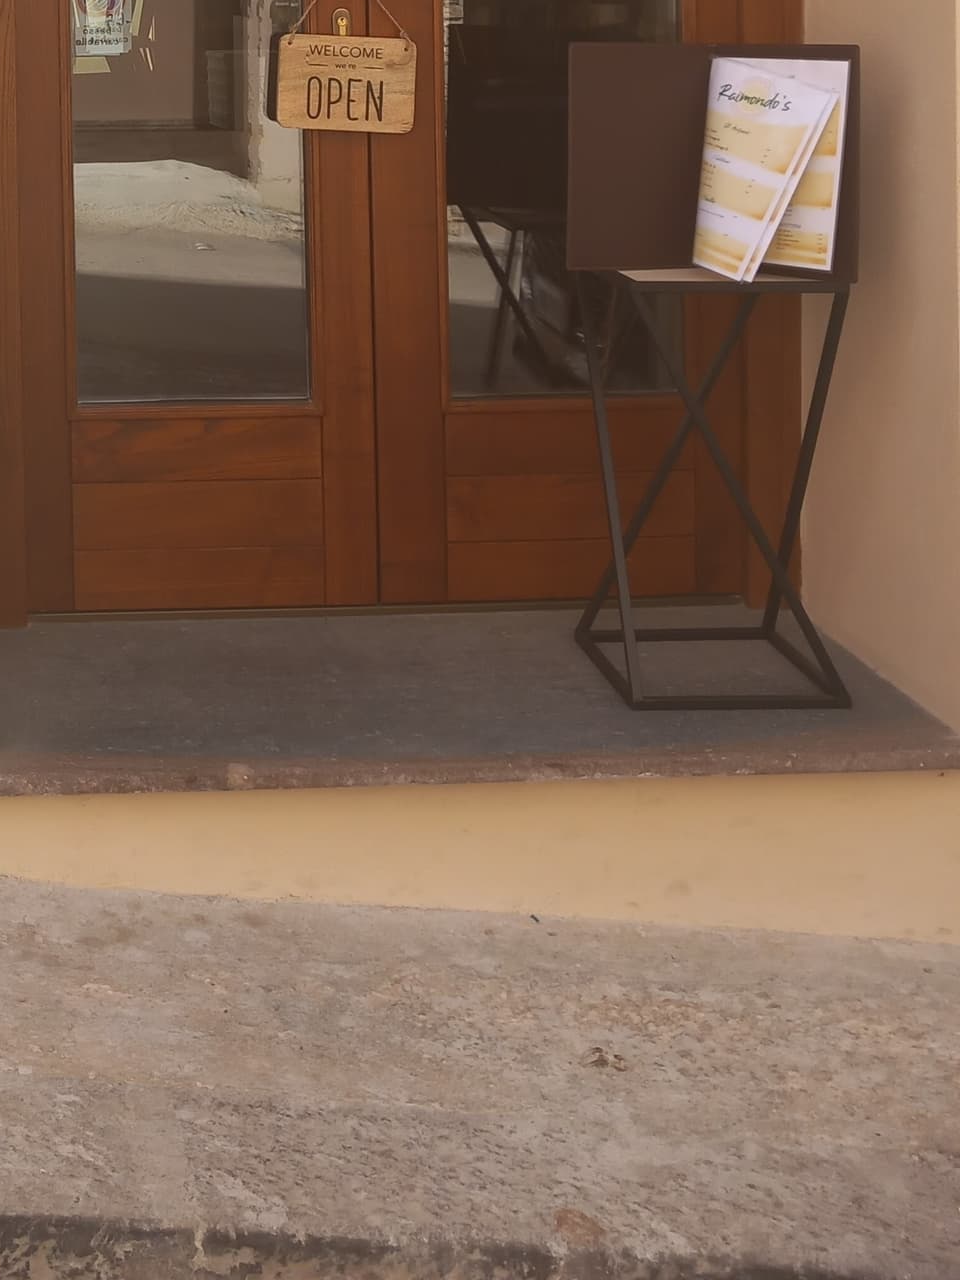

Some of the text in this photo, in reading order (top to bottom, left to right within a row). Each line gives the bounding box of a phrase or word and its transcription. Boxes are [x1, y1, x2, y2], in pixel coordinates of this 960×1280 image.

[309, 44, 384, 59] WELCOME
[306, 76, 383, 121] OPEN
[718, 83, 792, 111] Raimondo's
